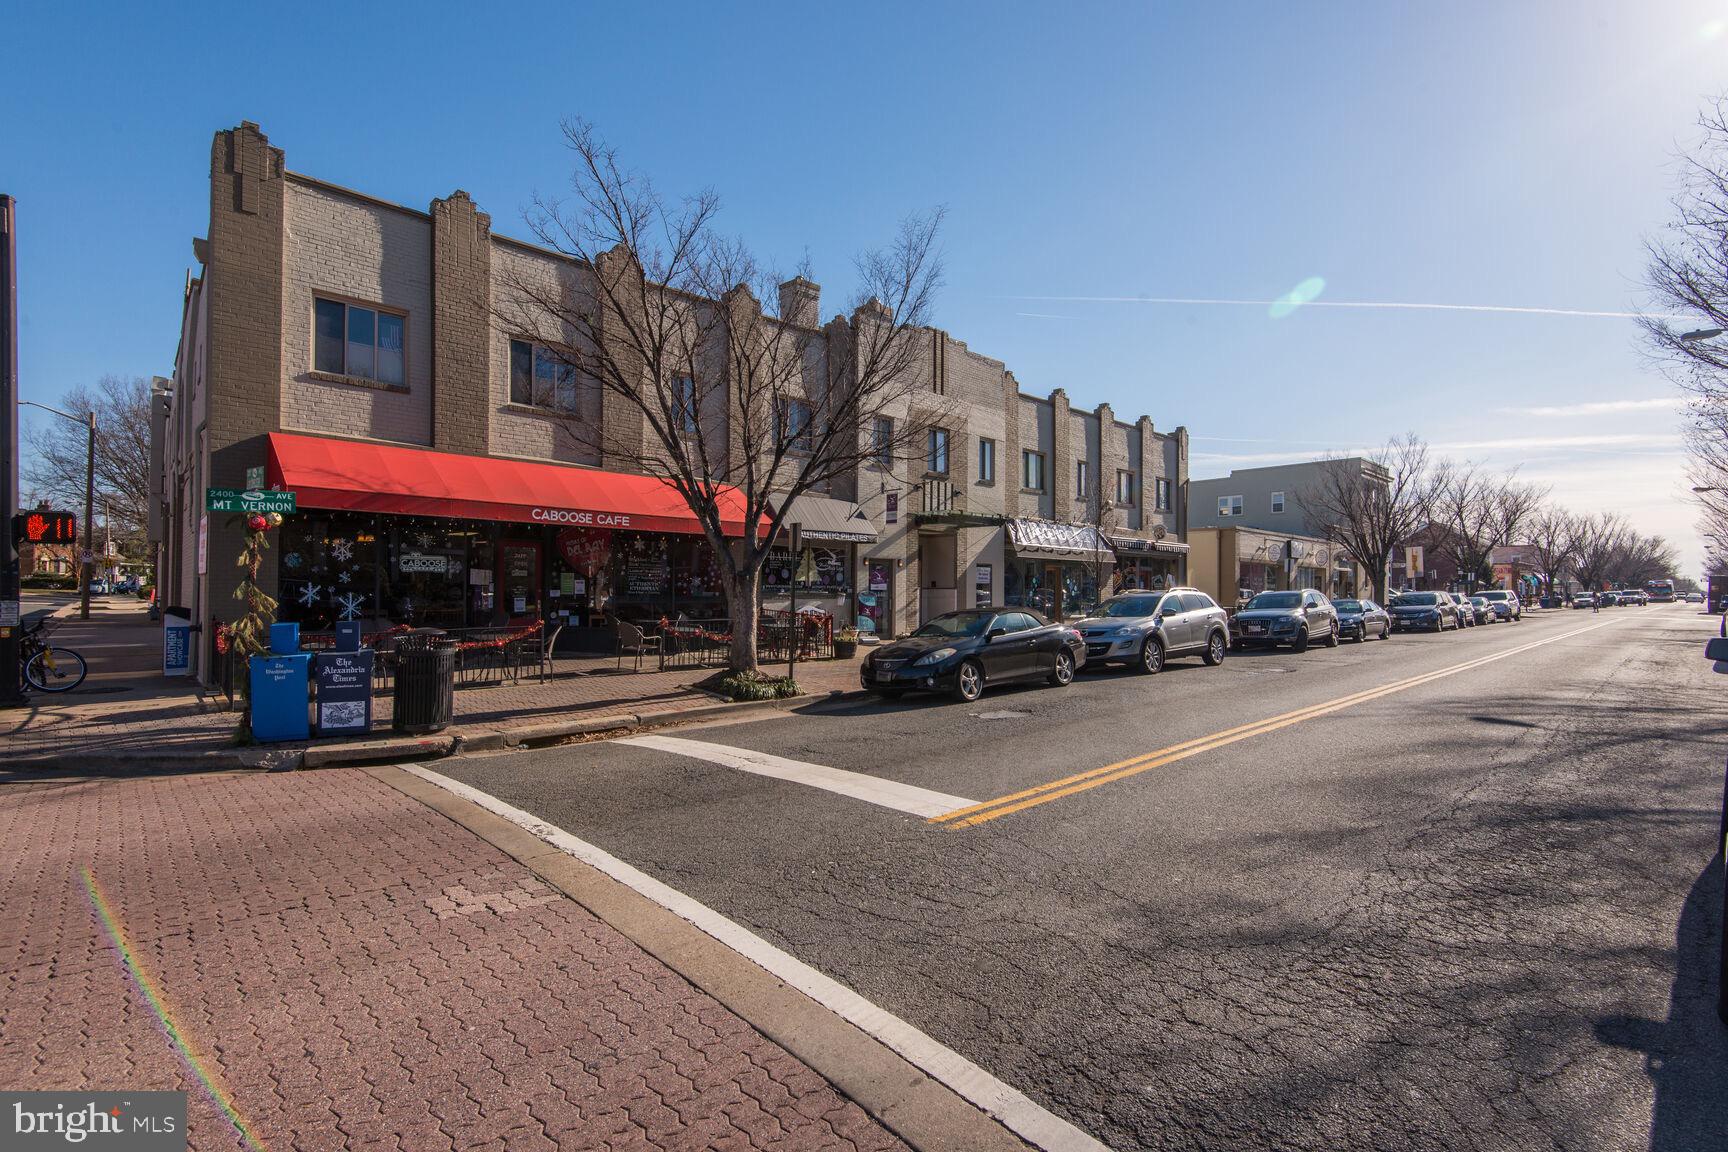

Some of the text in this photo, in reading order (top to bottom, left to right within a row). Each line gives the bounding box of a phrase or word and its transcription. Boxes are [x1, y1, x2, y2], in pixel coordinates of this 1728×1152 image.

[210, 490, 234, 498] 2400
[213, 500, 292, 512] MT VERNON
[532, 508, 630, 526] CABOOSE CAFE
[56, 518, 73, 539] 11
[841, 532, 868, 542] PILATES
[401, 559, 447, 567] CABOOSE
[167, 630, 177, 666] APARTMENT
[336, 657, 352, 667] The
[322, 666, 365, 676] Alexandria
[333, 674, 357, 682] Times
